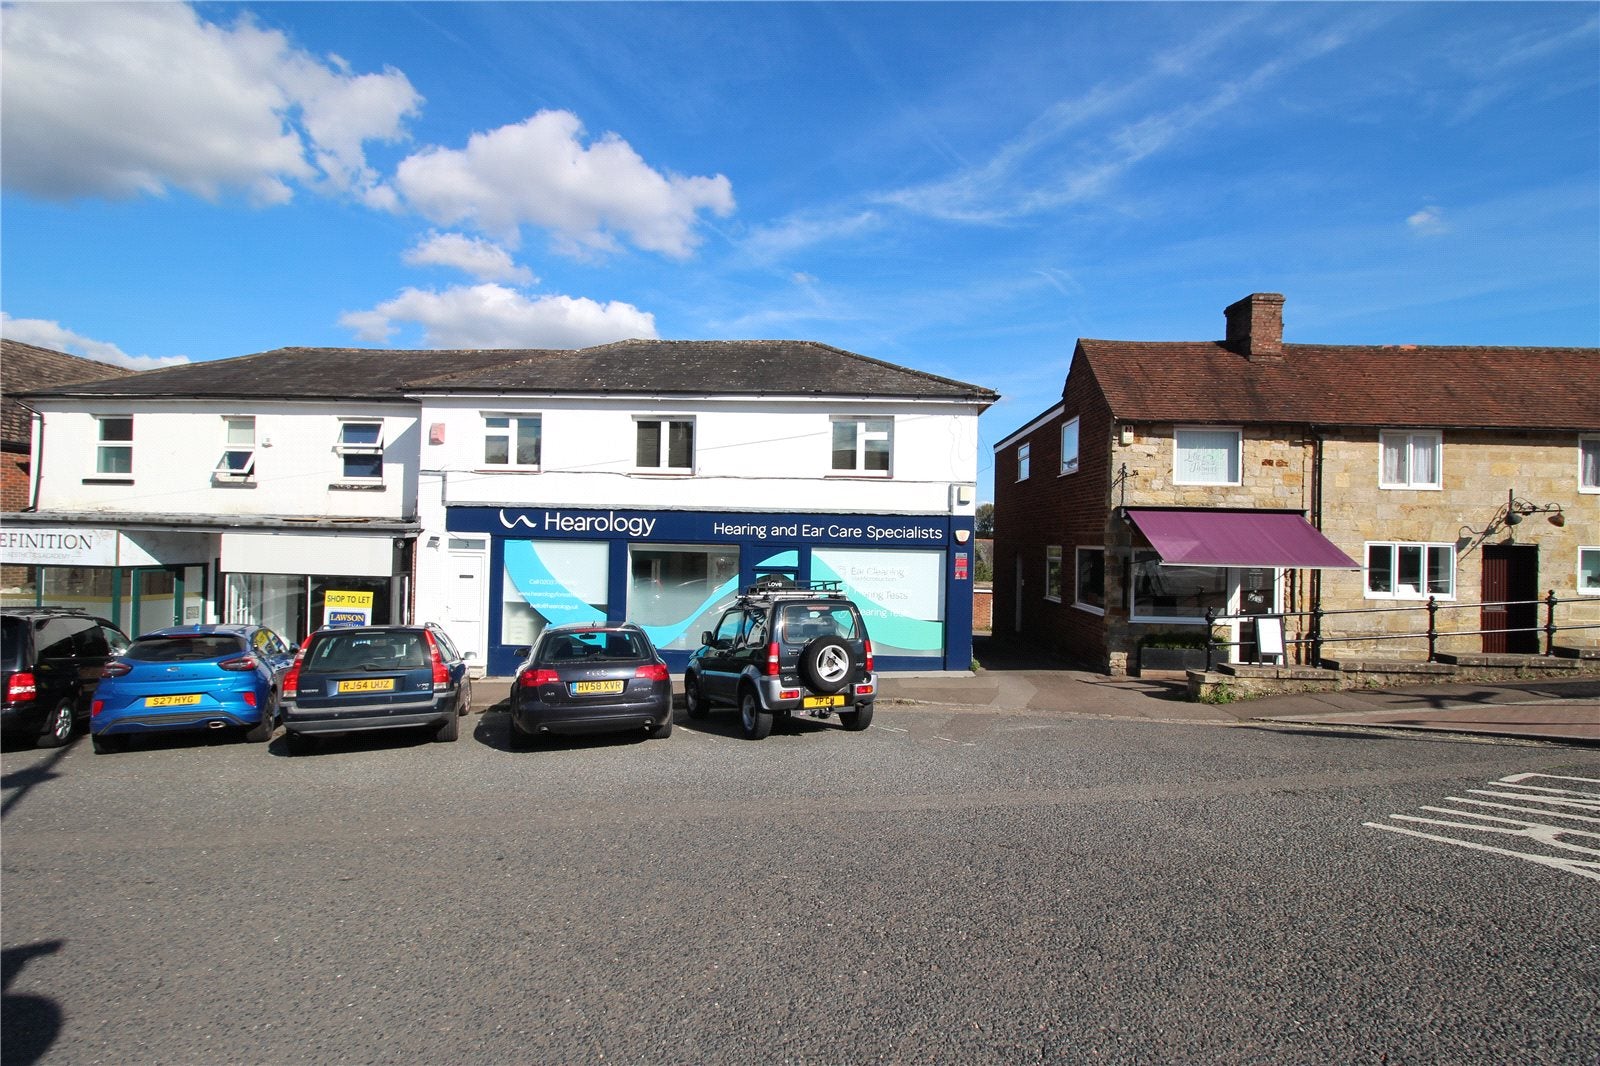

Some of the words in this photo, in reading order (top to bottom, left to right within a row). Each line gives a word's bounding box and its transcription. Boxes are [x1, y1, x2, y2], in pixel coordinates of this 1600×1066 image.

[544, 511, 656, 537] Hearology
[713, 522, 767, 539] Hearing
[771, 523, 797, 537] and
[802, 525, 824, 538] Ear
[828, 525, 862, 538] Care
[867, 526, 942, 540] Specialists
[851, 567, 863, 576] Ear
[867, 567, 905, 579] Cleaning
[327, 595, 345, 603] SHOP
[347, 596, 357, 604] TO
[358, 596, 371, 604] LET
[887, 591, 908, 600] Tests
[330, 613, 365, 622] LAWSON
[860, 609, 888, 619] earing
[578, 682, 602, 691] HV58
[604, 681, 621, 690] XVR
[153, 697, 172, 705] S27
[174, 695, 194, 704] HYG
